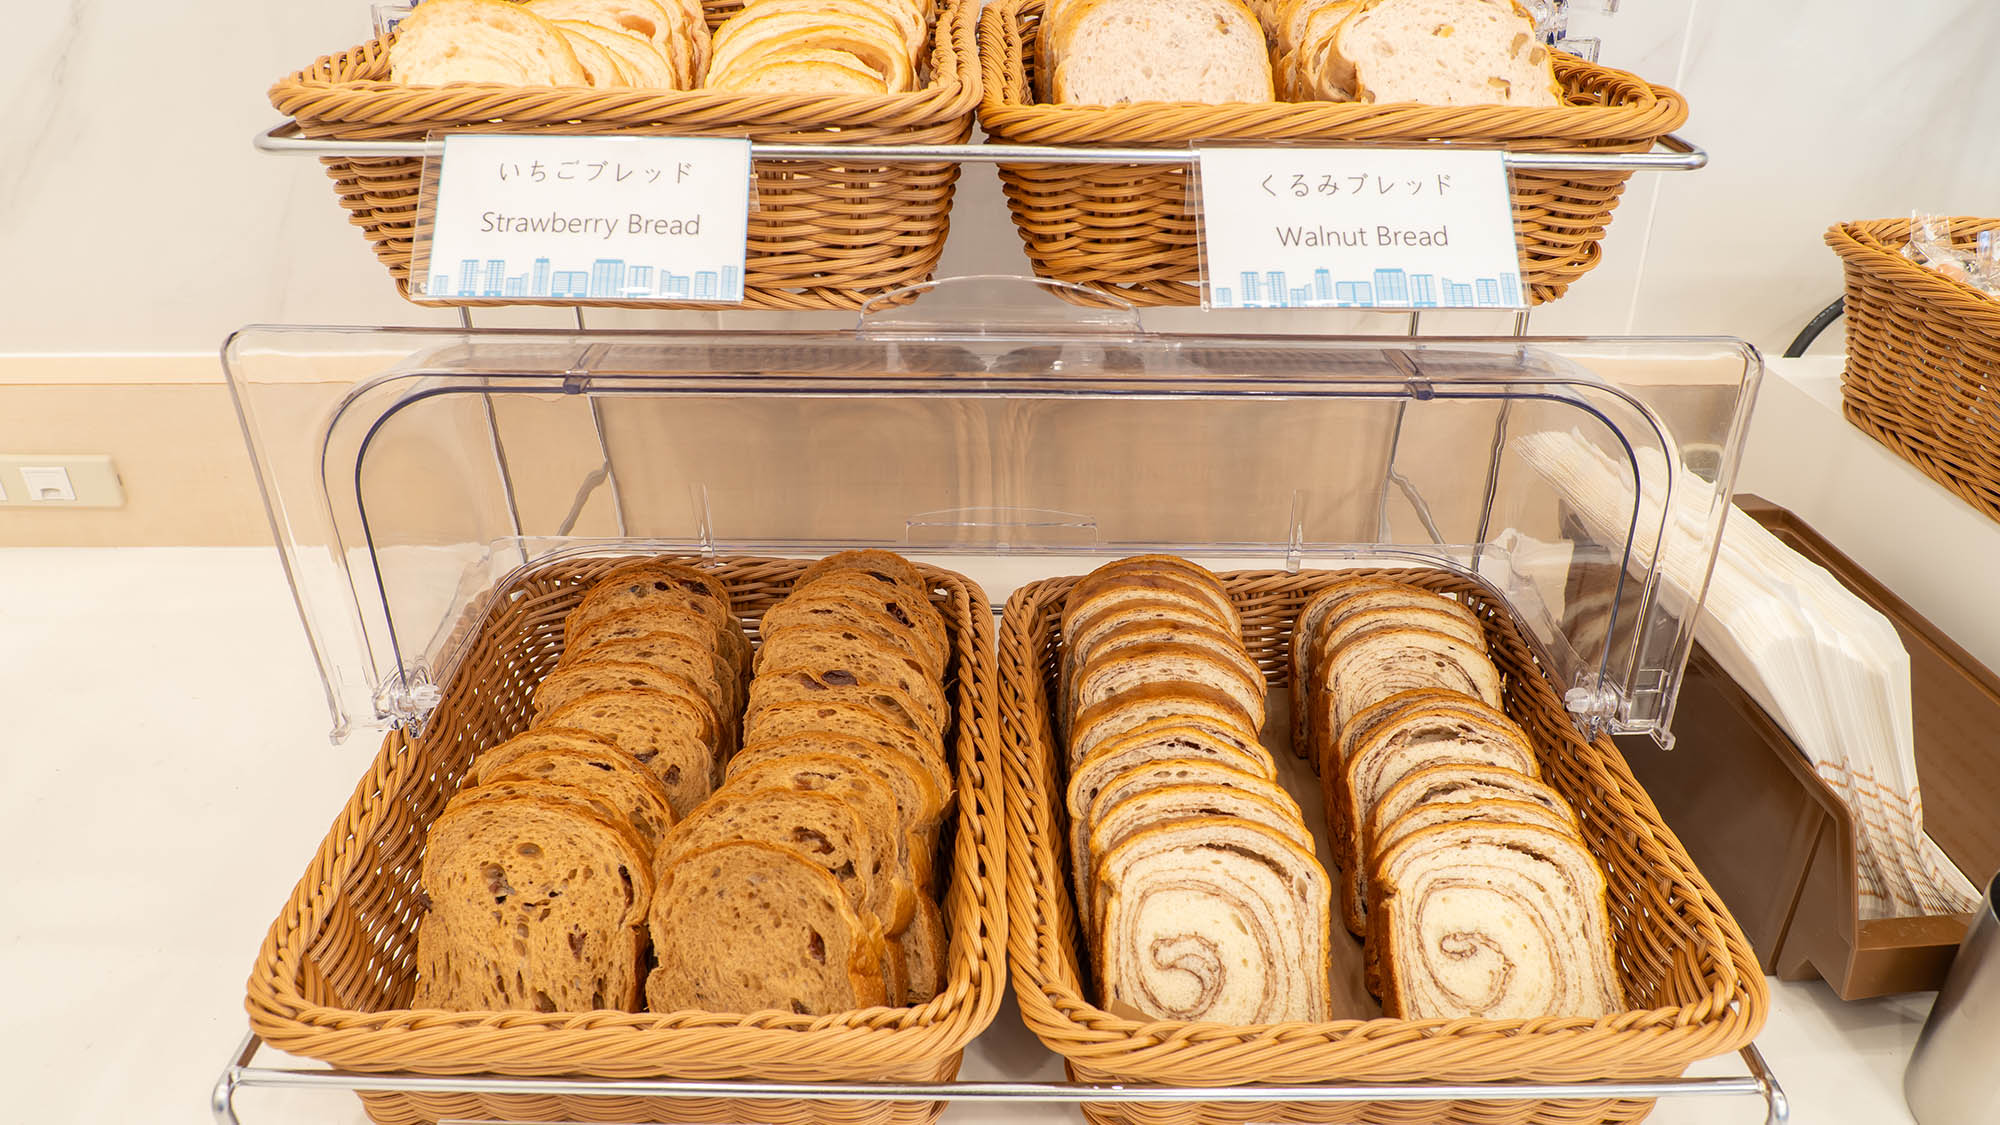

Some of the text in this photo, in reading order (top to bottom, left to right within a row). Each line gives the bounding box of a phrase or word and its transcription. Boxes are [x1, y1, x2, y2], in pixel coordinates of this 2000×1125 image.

[499, 160, 692, 184] いちごブレッド
[1261, 173, 1451, 197] くるみブレッド
[480, 211, 700, 239] Strawberry Bread
[1276, 225, 1449, 247] Walnut Bread
